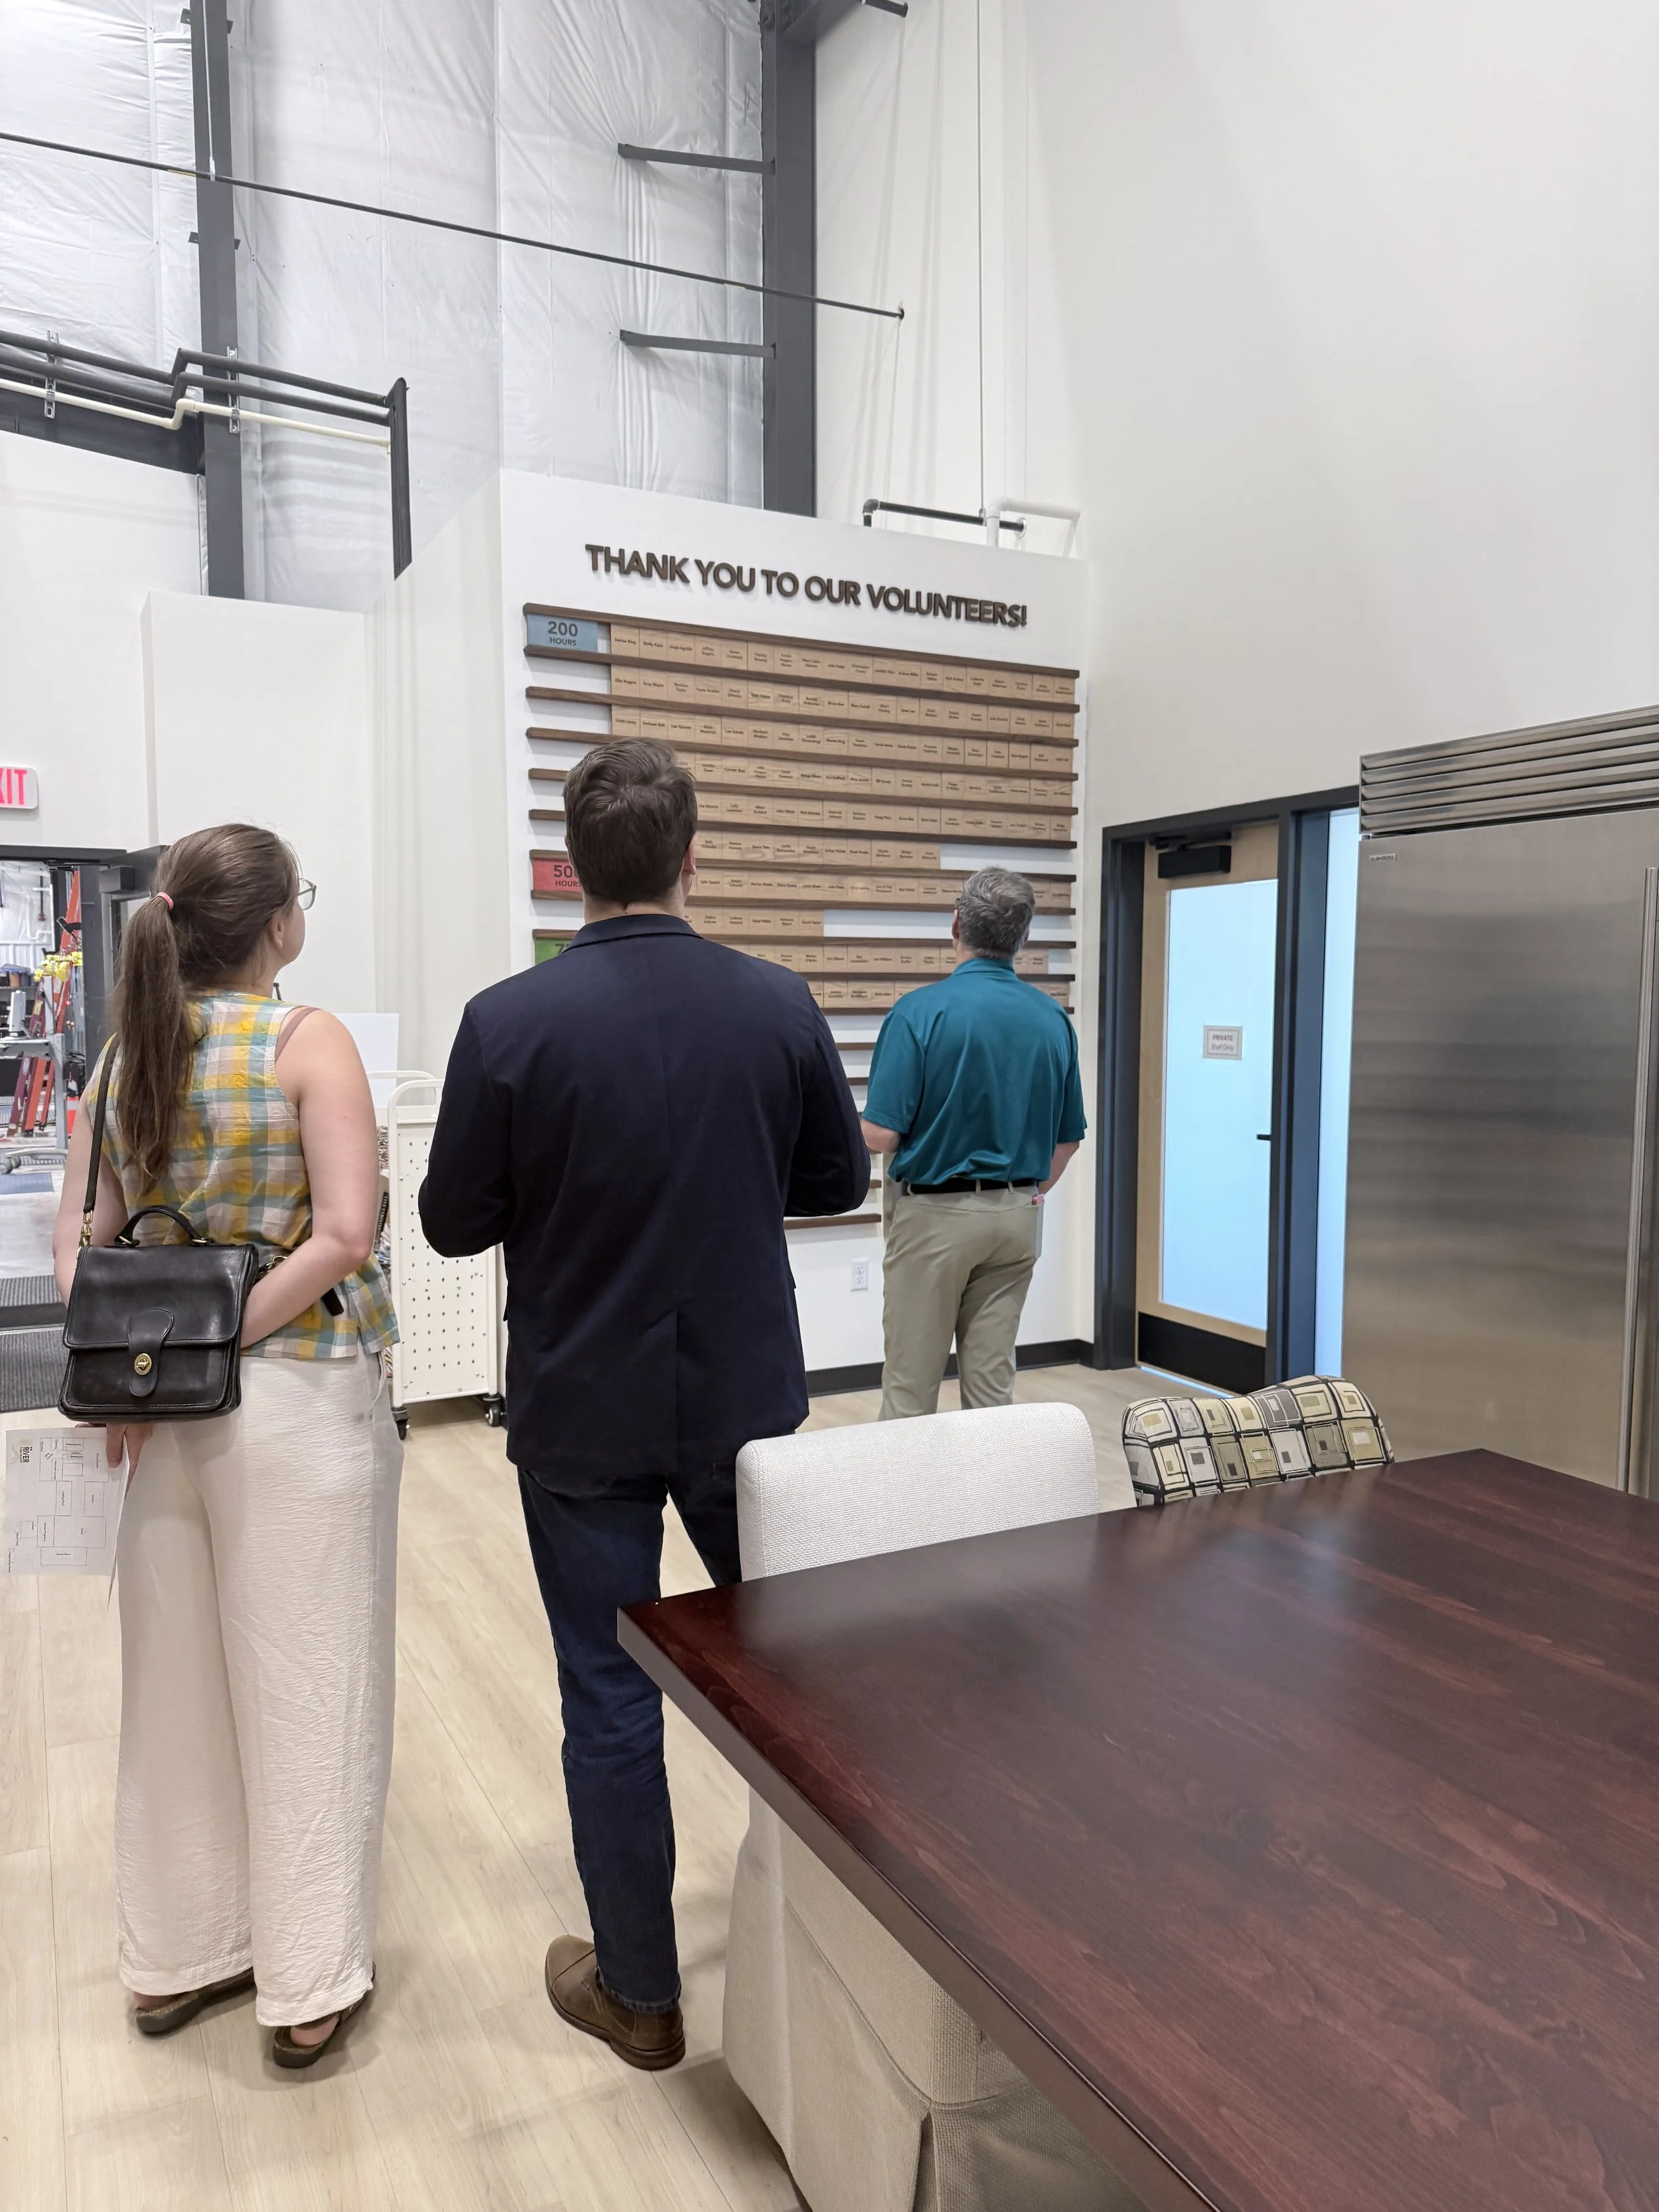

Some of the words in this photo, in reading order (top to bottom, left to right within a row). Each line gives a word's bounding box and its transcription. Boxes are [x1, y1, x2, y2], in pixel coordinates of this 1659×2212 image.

[585, 544, 690, 584] THANK
[695, 559, 756, 593] YOU
[761, 569, 800, 598] TO
[804, 576, 861, 606] OUR
[867, 583, 1027, 627] VOLUNTEERS!
[547, 621, 578, 636] 200
[549, 637, 577, 646] HOURS
[1222, 1044, 1234, 1053] Only
